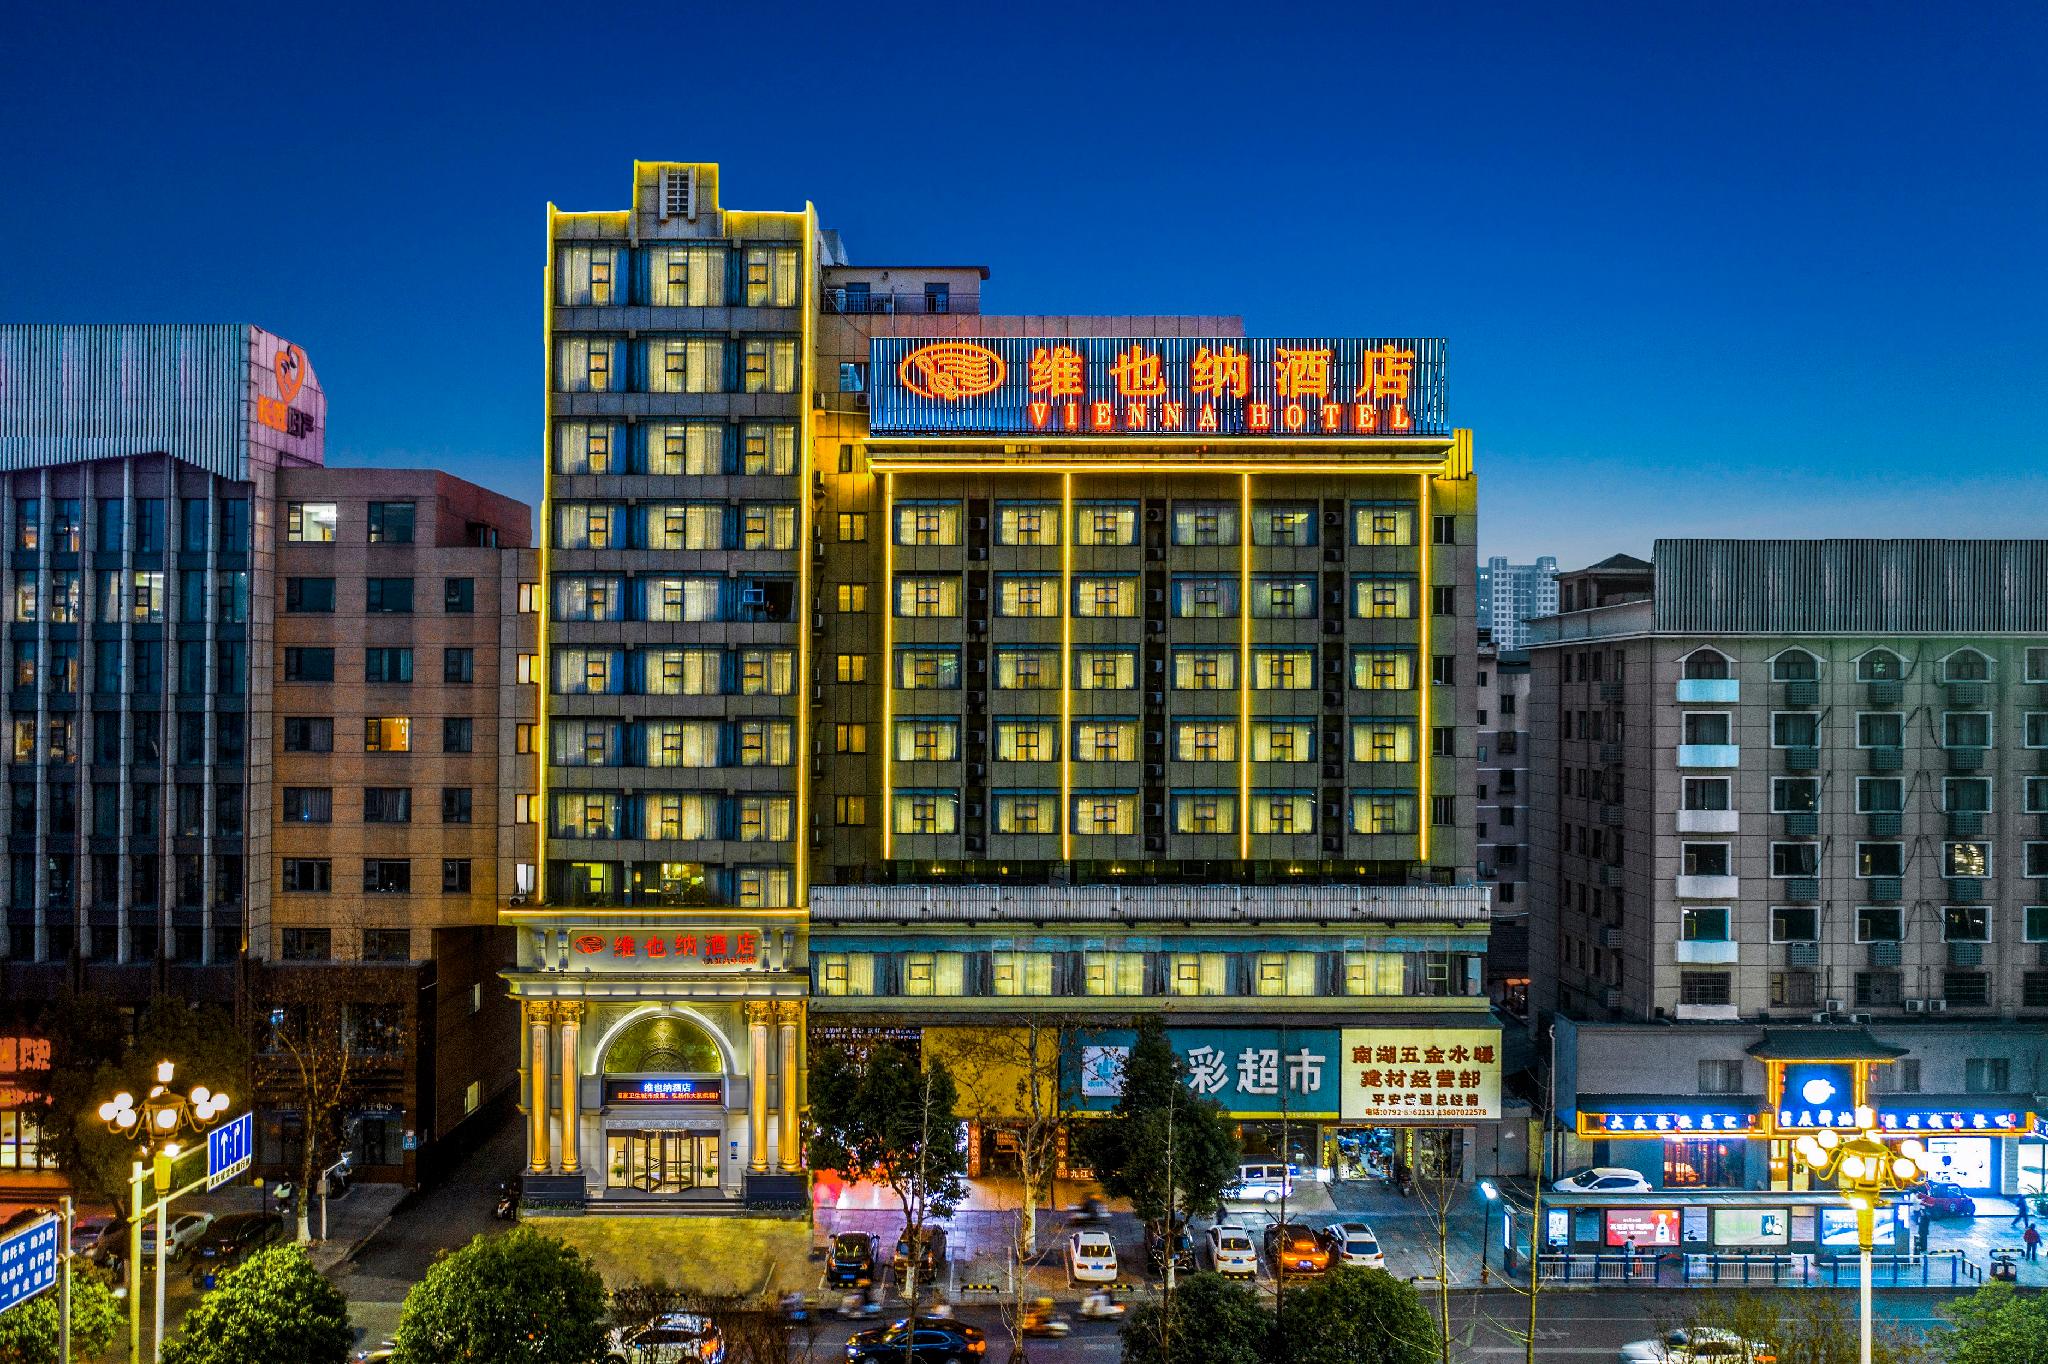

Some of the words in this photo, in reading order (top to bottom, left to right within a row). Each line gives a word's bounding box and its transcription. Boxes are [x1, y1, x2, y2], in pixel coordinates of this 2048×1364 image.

[1029, 344, 1416, 399] 维也纳酒店
[1030, 402, 1218, 428] VIENNA
[1250, 402, 1411, 428] HOTEL
[613, 932, 757, 958] 维也纳酒店
[1352, 1045, 1495, 1064] 南湖五金水暖
[644, 1083, 691, 1092] 维也纳酒店
[1361, 1069, 1481, 1088] 建材经营部
